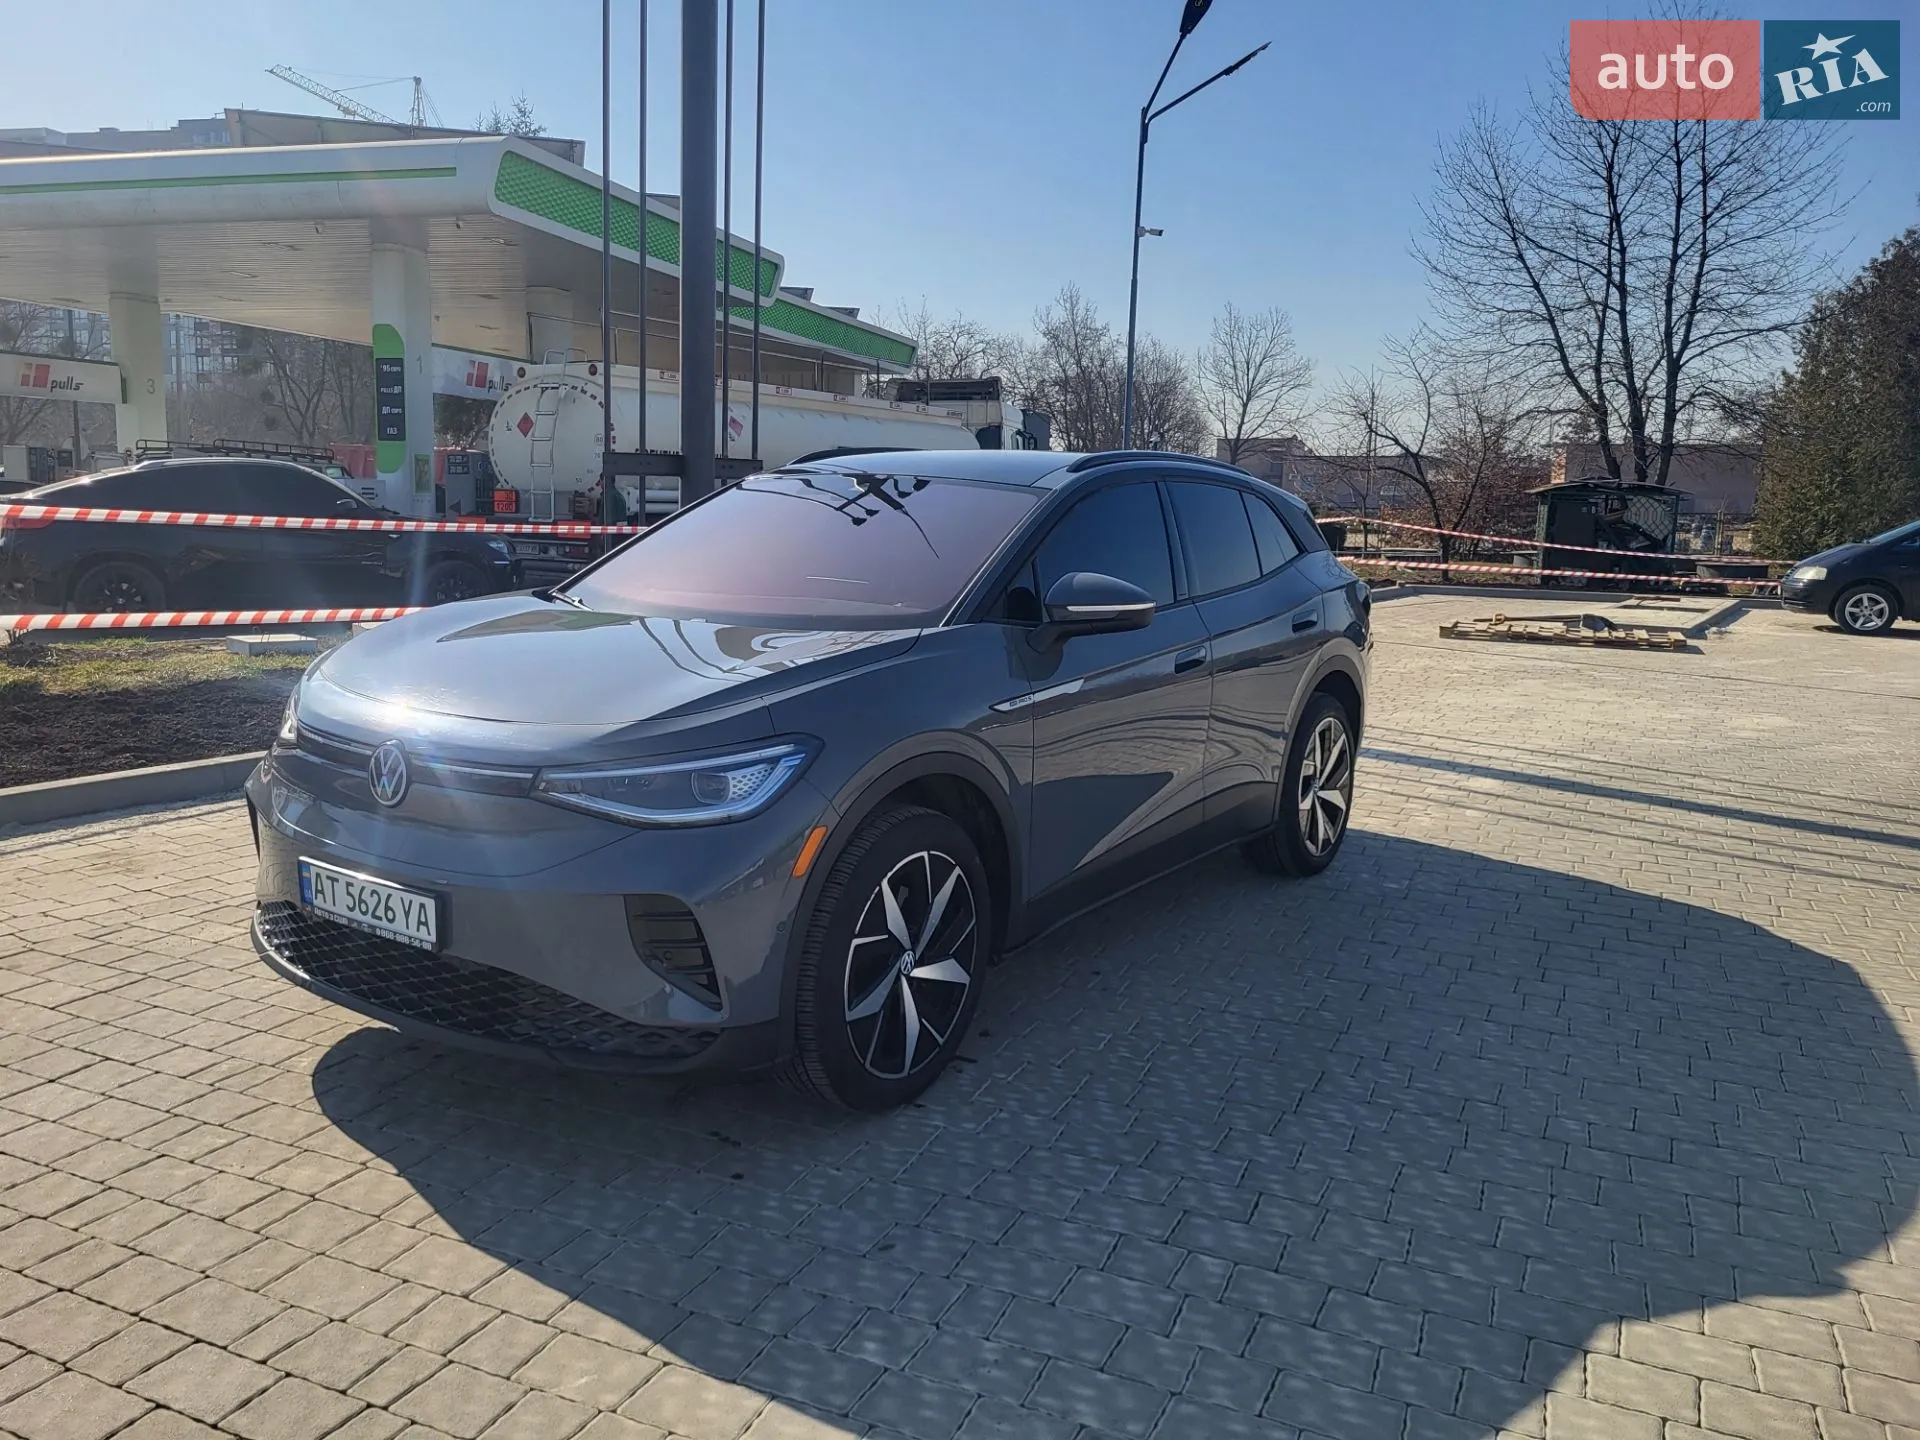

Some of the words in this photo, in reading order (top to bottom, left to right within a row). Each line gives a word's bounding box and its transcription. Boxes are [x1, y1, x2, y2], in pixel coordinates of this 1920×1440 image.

[50, 376, 84, 393] pulls
[146, 378, 156, 394] 3
[487, 375, 512, 394] pulls
[314, 872, 339, 907] AT
[345, 881, 396, 924] 5626
[400, 896, 431, 936] YA
